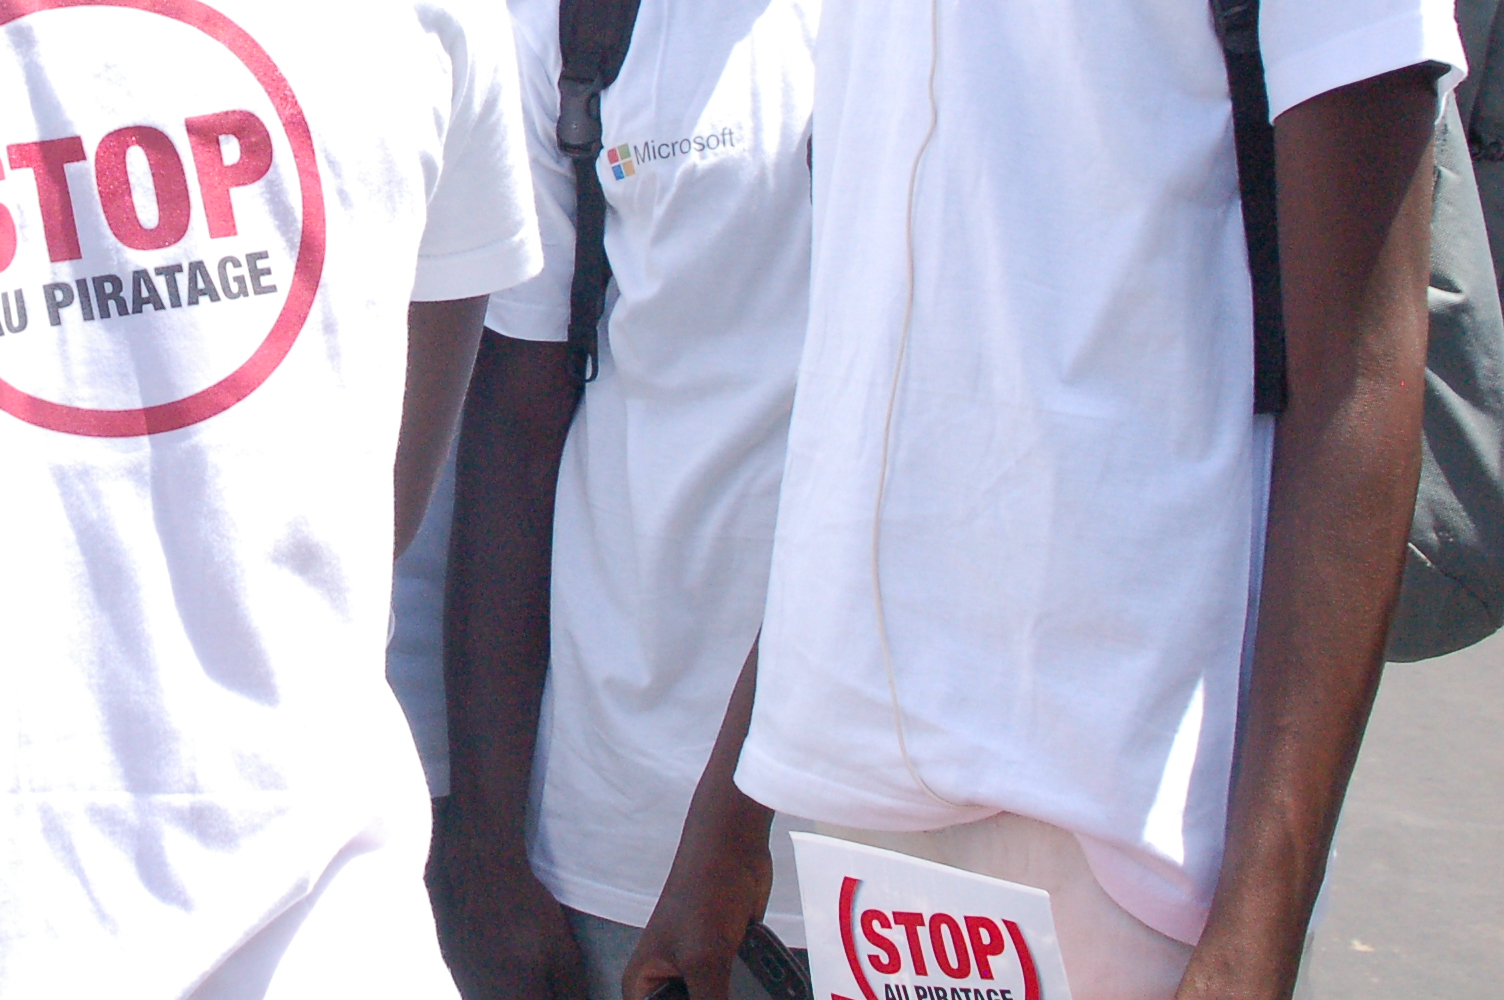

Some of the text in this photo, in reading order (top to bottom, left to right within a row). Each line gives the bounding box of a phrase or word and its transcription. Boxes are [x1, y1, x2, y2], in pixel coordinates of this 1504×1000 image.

[633, 127, 736, 165] Microsoft
[43, 250, 278, 327] PIRATAGE
[860, 908, 1005, 980] STOP
